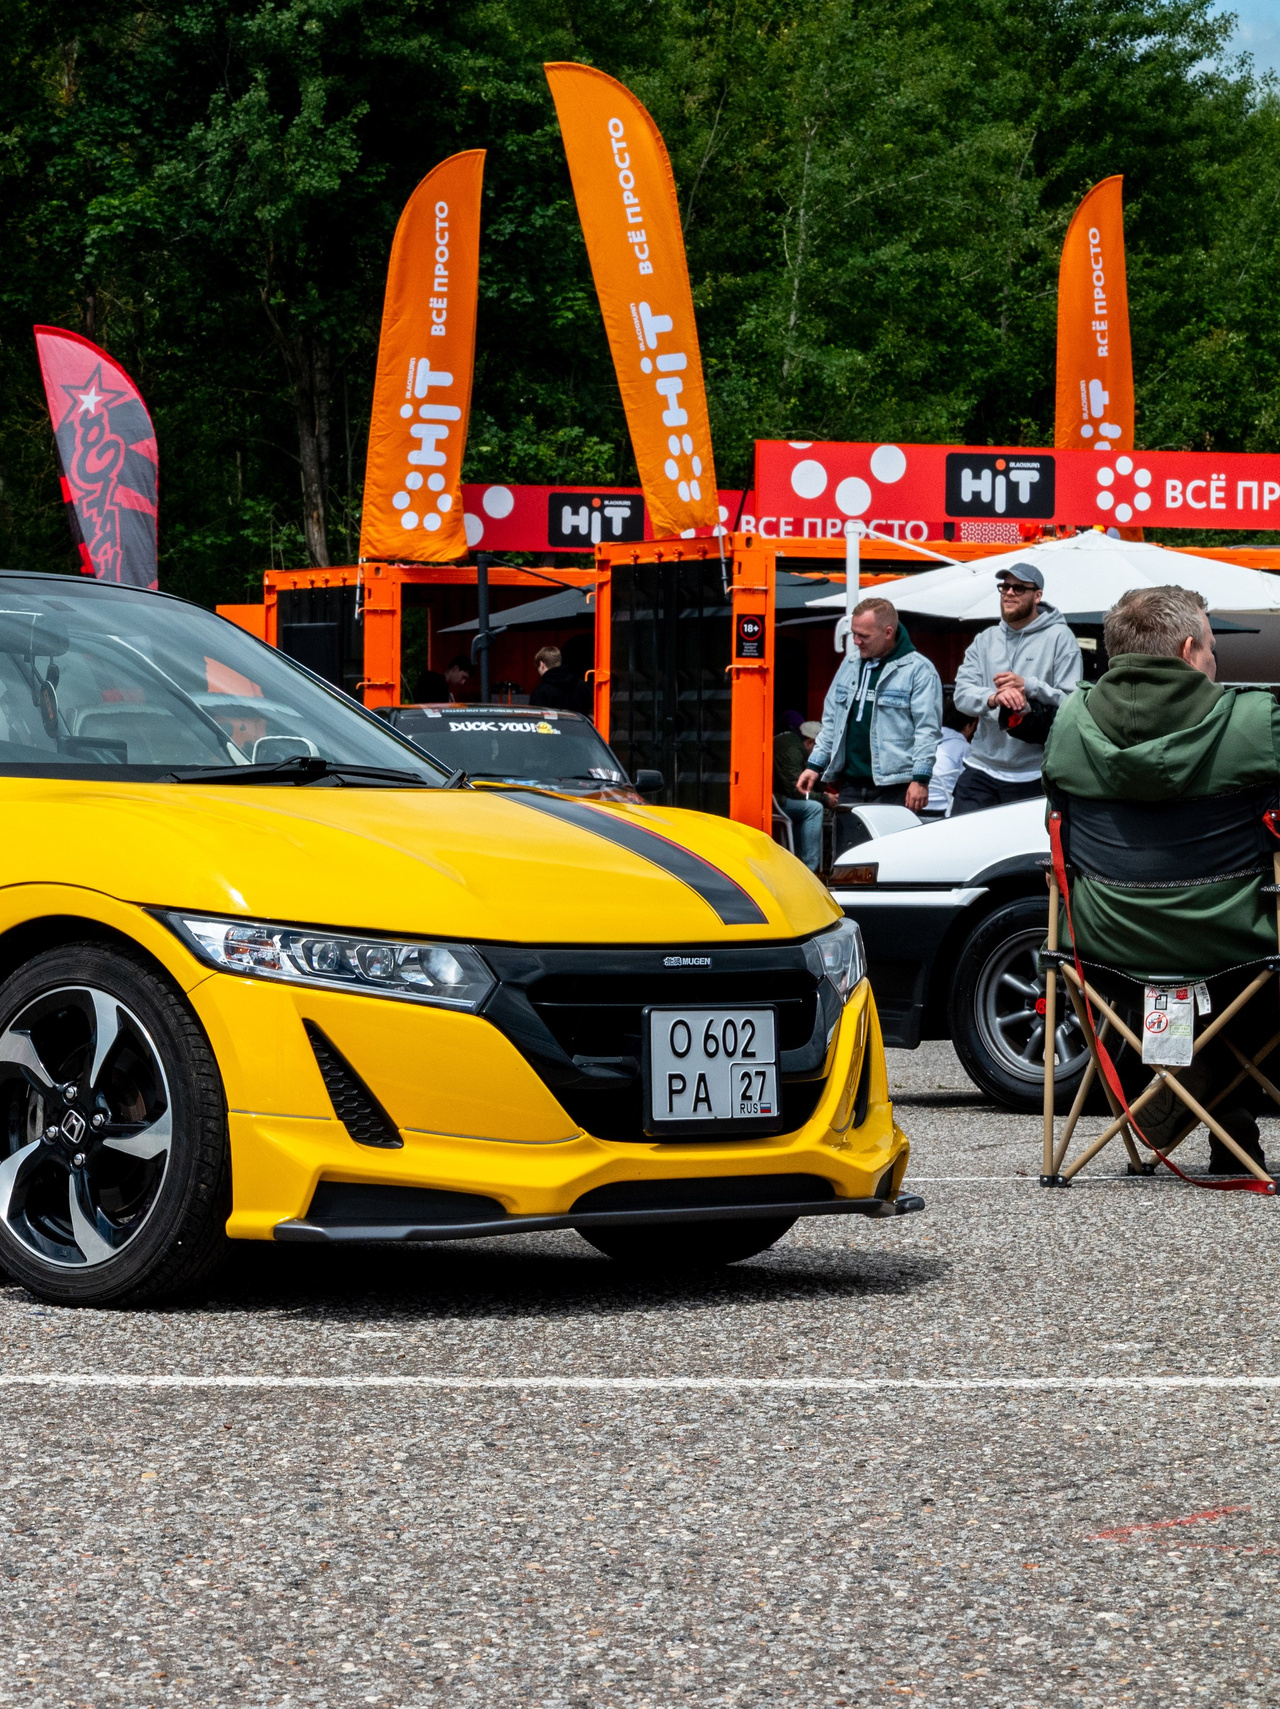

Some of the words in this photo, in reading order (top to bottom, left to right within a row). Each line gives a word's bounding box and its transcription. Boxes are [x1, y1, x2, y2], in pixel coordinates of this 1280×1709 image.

[607, 117, 643, 224] ПРОСТО
[433, 201, 449, 292] ПРОСТО
[628, 229, 654, 276] ВСЁ
[1088, 227, 1108, 315] ПРОСТО
[429, 297, 448, 337] ВСЁ
[1165, 473, 1227, 510] ВСЁ
[743, 623, 760, 633] 18+
[448, 721, 499, 733] DUCK
[498, 721, 537, 733] YOU!
[682, 957, 711, 966] MUGEN
[703, 1018, 757, 1059] 602
[739, 1070, 767, 1102] 27
[739, 1103, 759, 1114] RUS
